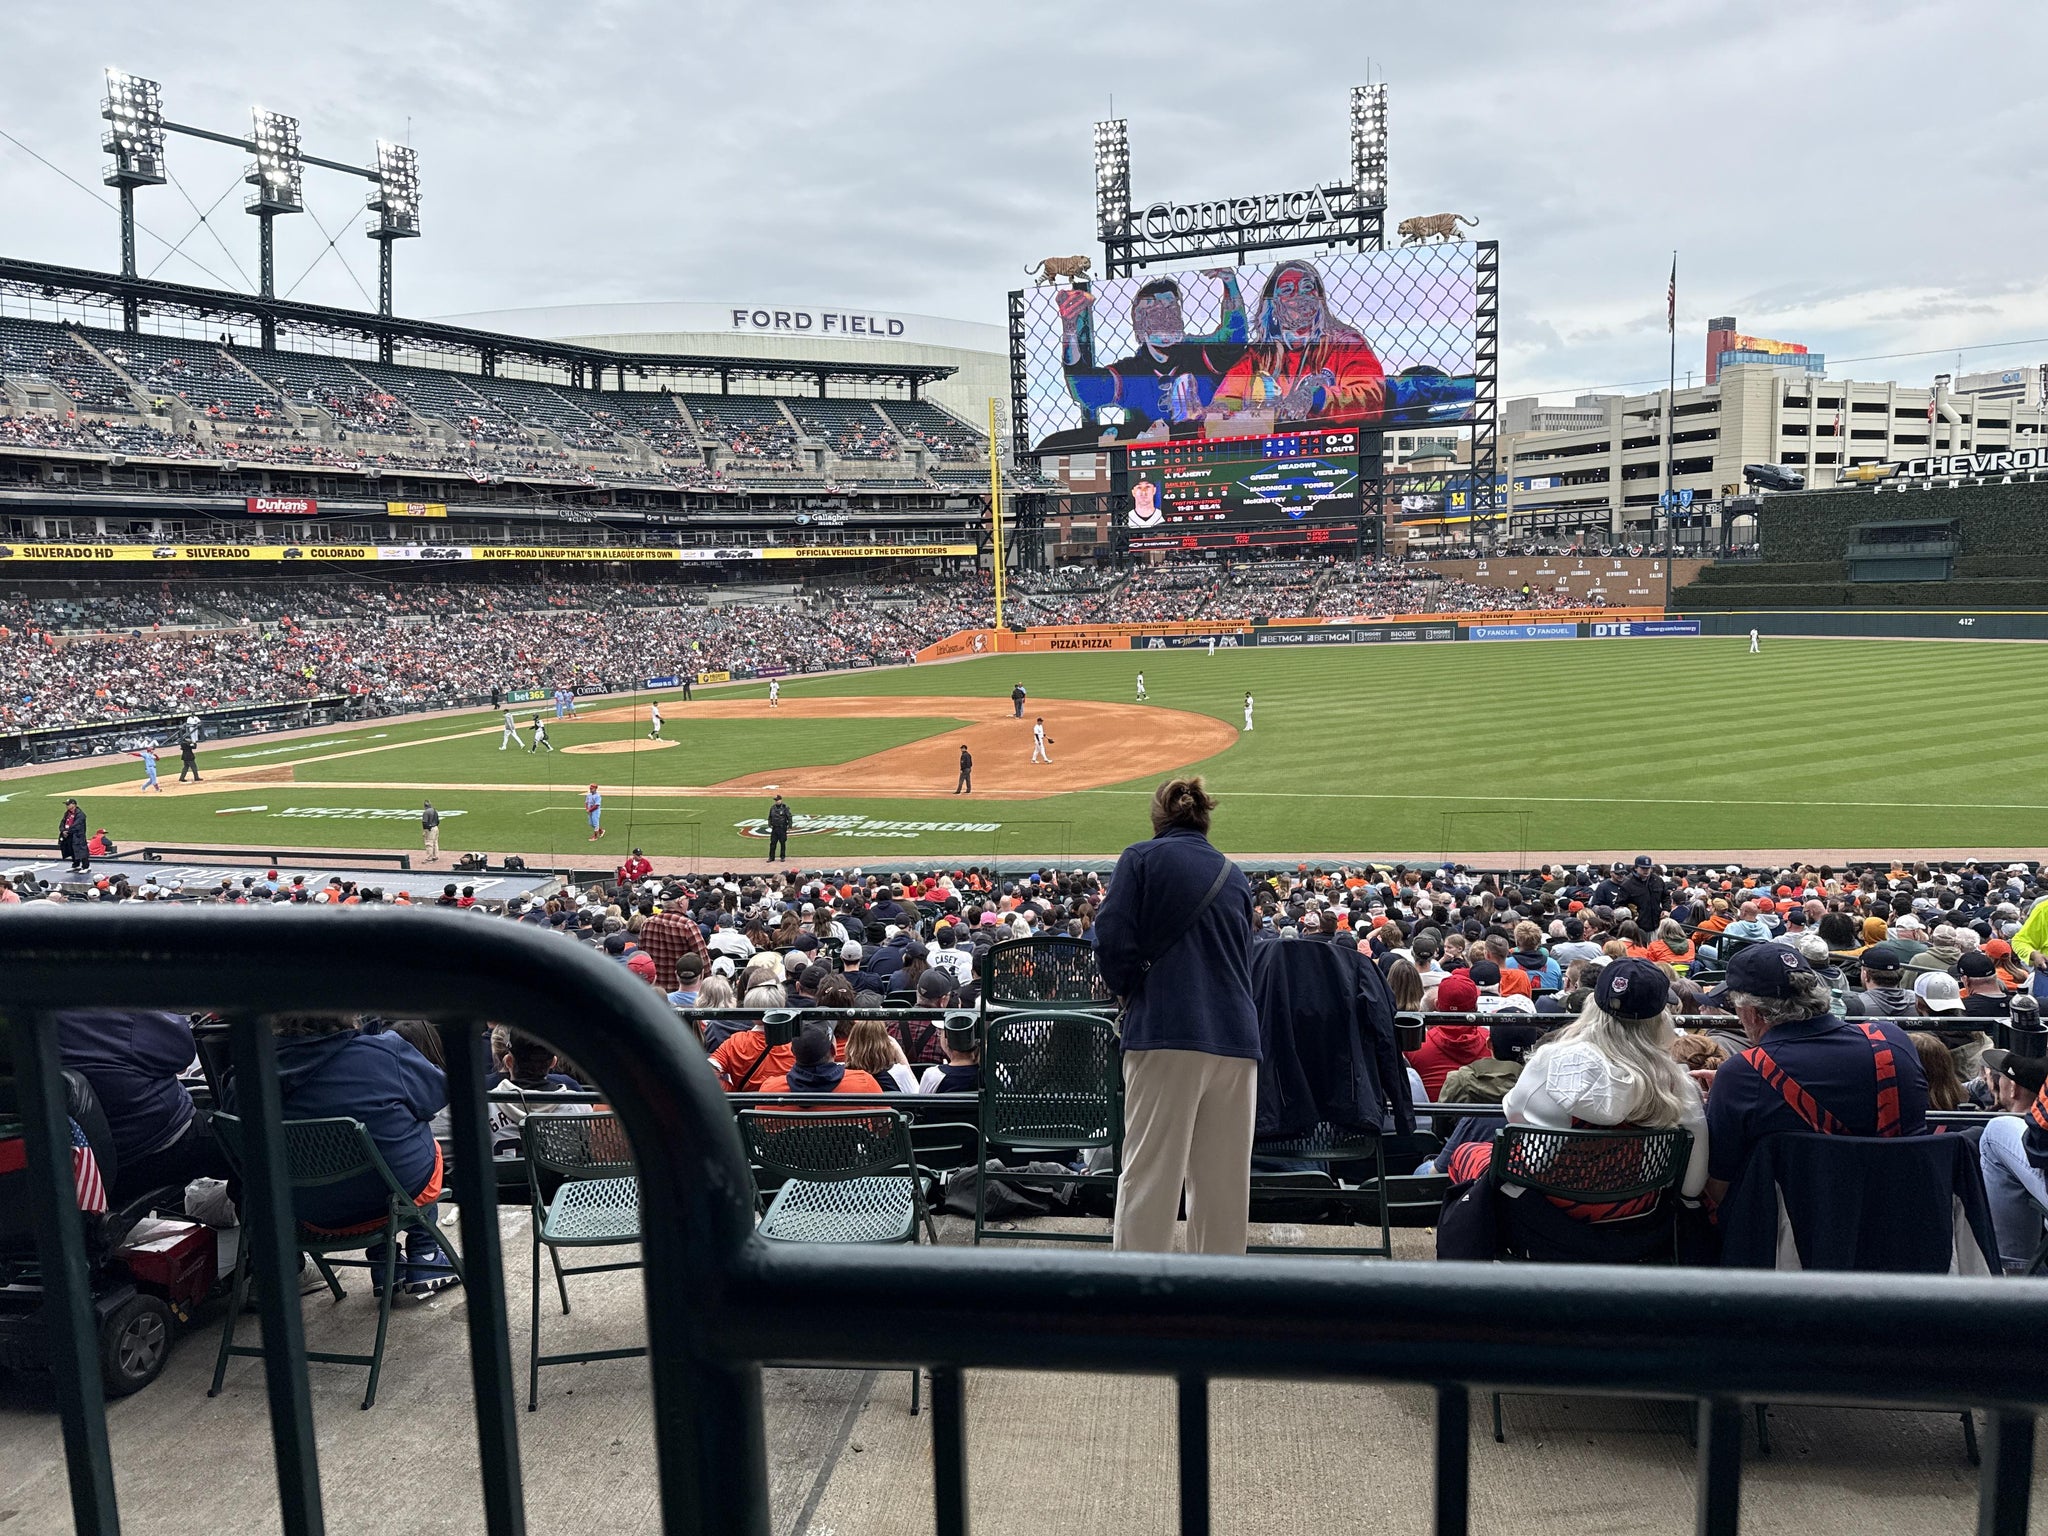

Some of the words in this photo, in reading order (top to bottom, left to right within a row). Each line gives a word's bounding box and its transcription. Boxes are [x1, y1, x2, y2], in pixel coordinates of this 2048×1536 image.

[1194, 225, 1283, 249] PARK
[732, 309, 812, 329] FORD
[822, 313, 905, 336] FIELD
[1326, 434, 1354, 445] 0-0
[1278, 462, 1316, 470] MEADOWS
[1172, 470, 1212, 478] FLAHERTY
[1494, 482, 1524, 494] HOSE
[1308, 492, 1354, 500] TORKELSON
[256, 498, 308, 510] Dunham's
[812, 514, 849, 523] Gallagher
[24, 548, 92, 558] SILVERADO
[95, 548, 114, 558] HD
[186, 548, 250, 558] SILVERADO
[310, 548, 365, 558] COLORADO
[538, 550, 566, 558] LINEUP
[796, 549, 831, 557] OFFICIAL
[1478, 562, 1487, 570] 23
[1654, 562, 1659, 570] 6
[1544, 560, 1548, 568] 5
[1578, 560, 1583, 568] 2
[1614, 560, 1622, 569] 16
[1558, 576, 1567, 584] 47
[1596, 578, 1600, 586] 3
[1638, 578, 1641, 587] 1
[1596, 624, 1631, 636] DTE
[1268, 634, 1302, 642] BETMGM
[1050, 640, 1080, 648] PIZZA!
[1082, 639, 1112, 648] PIZZA!
[514, 690, 545, 700] bet365
[734, 818, 863, 830] OPNING
[858, 820, 1002, 832] WEEKEND
[832, 830, 920, 838] Adobe
[935, 955, 958, 964] CASEY
